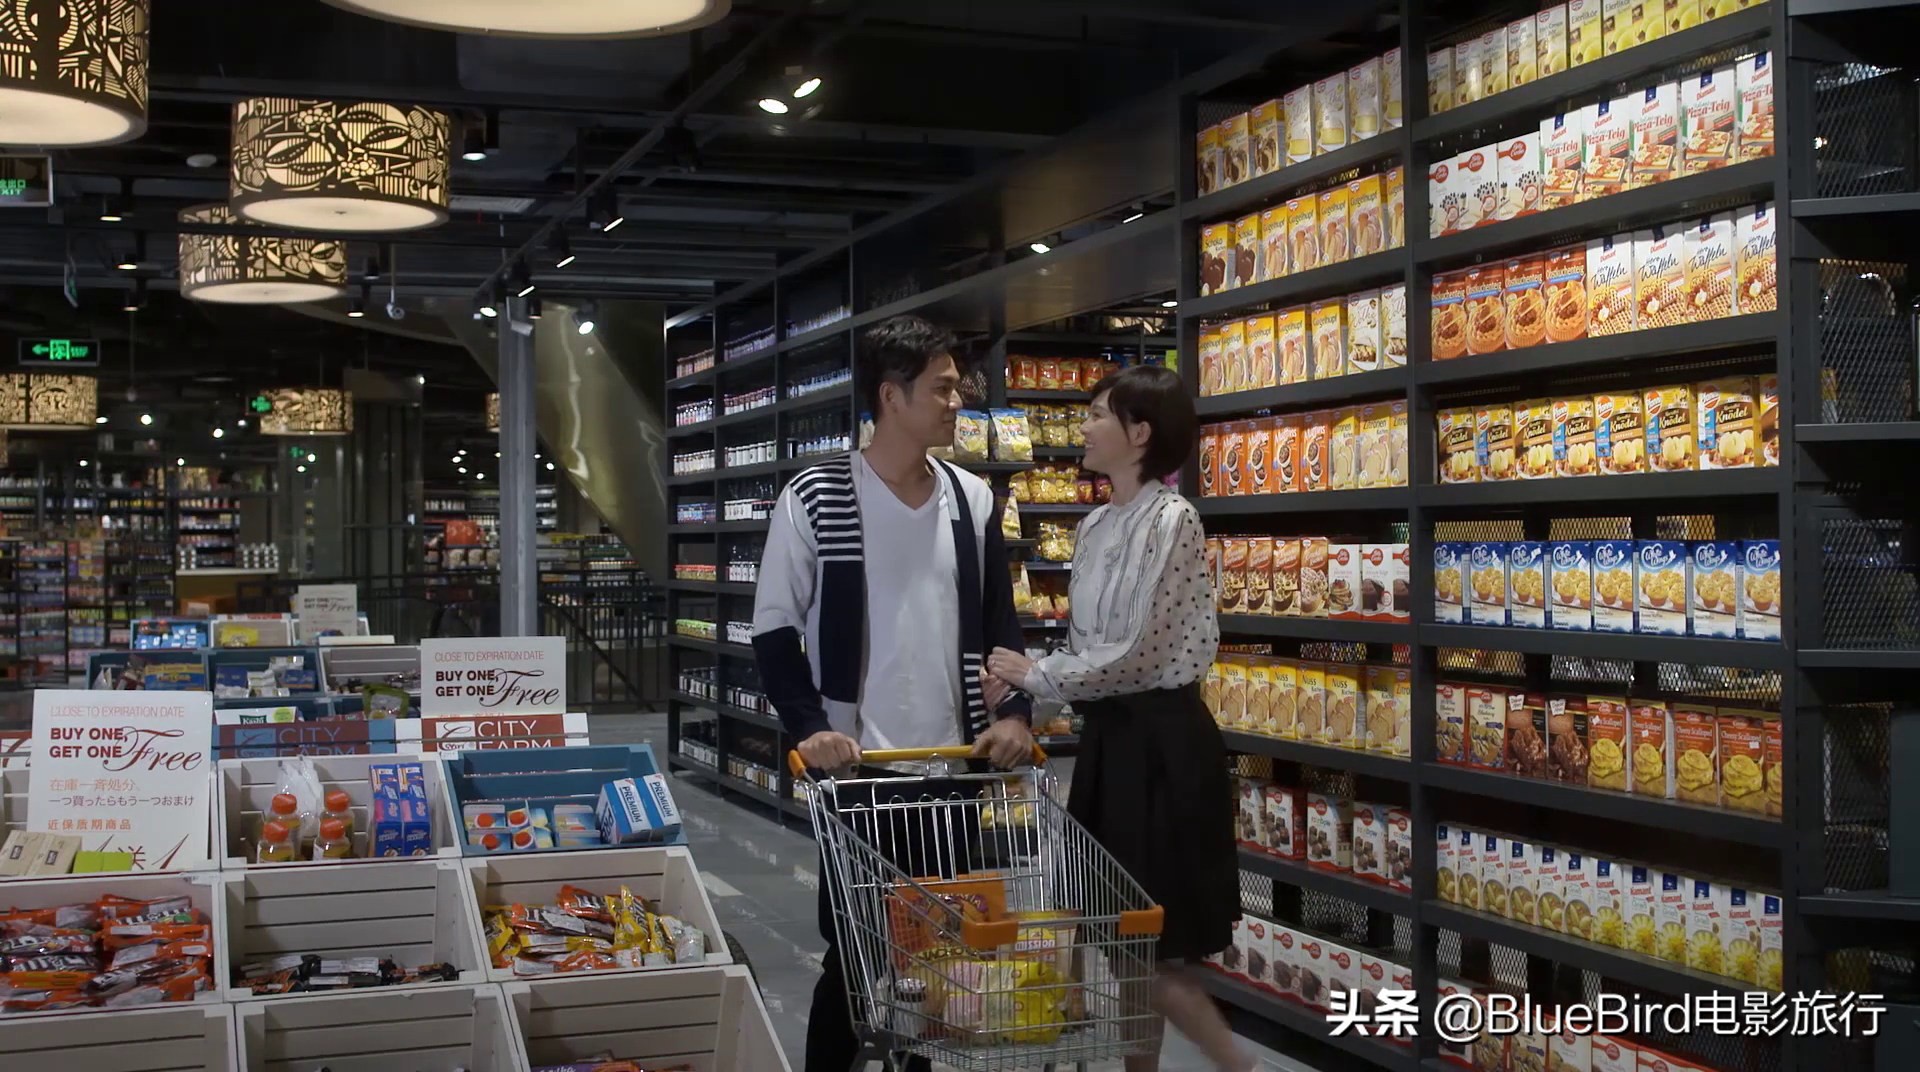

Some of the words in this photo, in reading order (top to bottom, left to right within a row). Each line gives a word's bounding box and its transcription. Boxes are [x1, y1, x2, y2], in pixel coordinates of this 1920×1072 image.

[1688, 243, 1727, 272] Waffeln
[1638, 253, 1679, 282] Waffeln
[1591, 262, 1628, 289] Waffeln
[1658, 413, 1686, 428] Knödel
[1715, 405, 1748, 423] Knödel
[1523, 424, 1546, 439] Knödel
[1565, 422, 1590, 436] Knödel
[1610, 417, 1637, 432] Knödel
[1645, 548, 1662, 561] White
[434, 651, 462, 664] CLOSE
[464, 651, 475, 662] TO
[476, 650, 523, 662] EXPIRATION
[523, 650, 544, 660] DATE
[435, 670, 463, 682] BUY
[466, 669, 499, 683] ONE,
[1332, 677, 1348, 688] Nuss
[435, 686, 462, 698] GET
[466, 685, 495, 697] ONE
[479, 667, 560, 707] Free
[87, 706, 100, 717] TO
[102, 706, 158, 718] EXPIRATION
[160, 706, 185, 718] DATE
[50, 727, 84, 740] BUY
[88, 727, 128, 743] ONE,
[279, 726, 341, 743] CITY
[477, 719, 537, 736] CITY
[49, 745, 83, 758] GET
[87, 745, 122, 758] ONE
[102, 726, 202, 772] Free
[48, 795, 195, 807] 一つ買ったらもう一つおまけ
[622, 786, 643, 823] PREMIUM
[652, 781, 674, 817] PREMIUM
